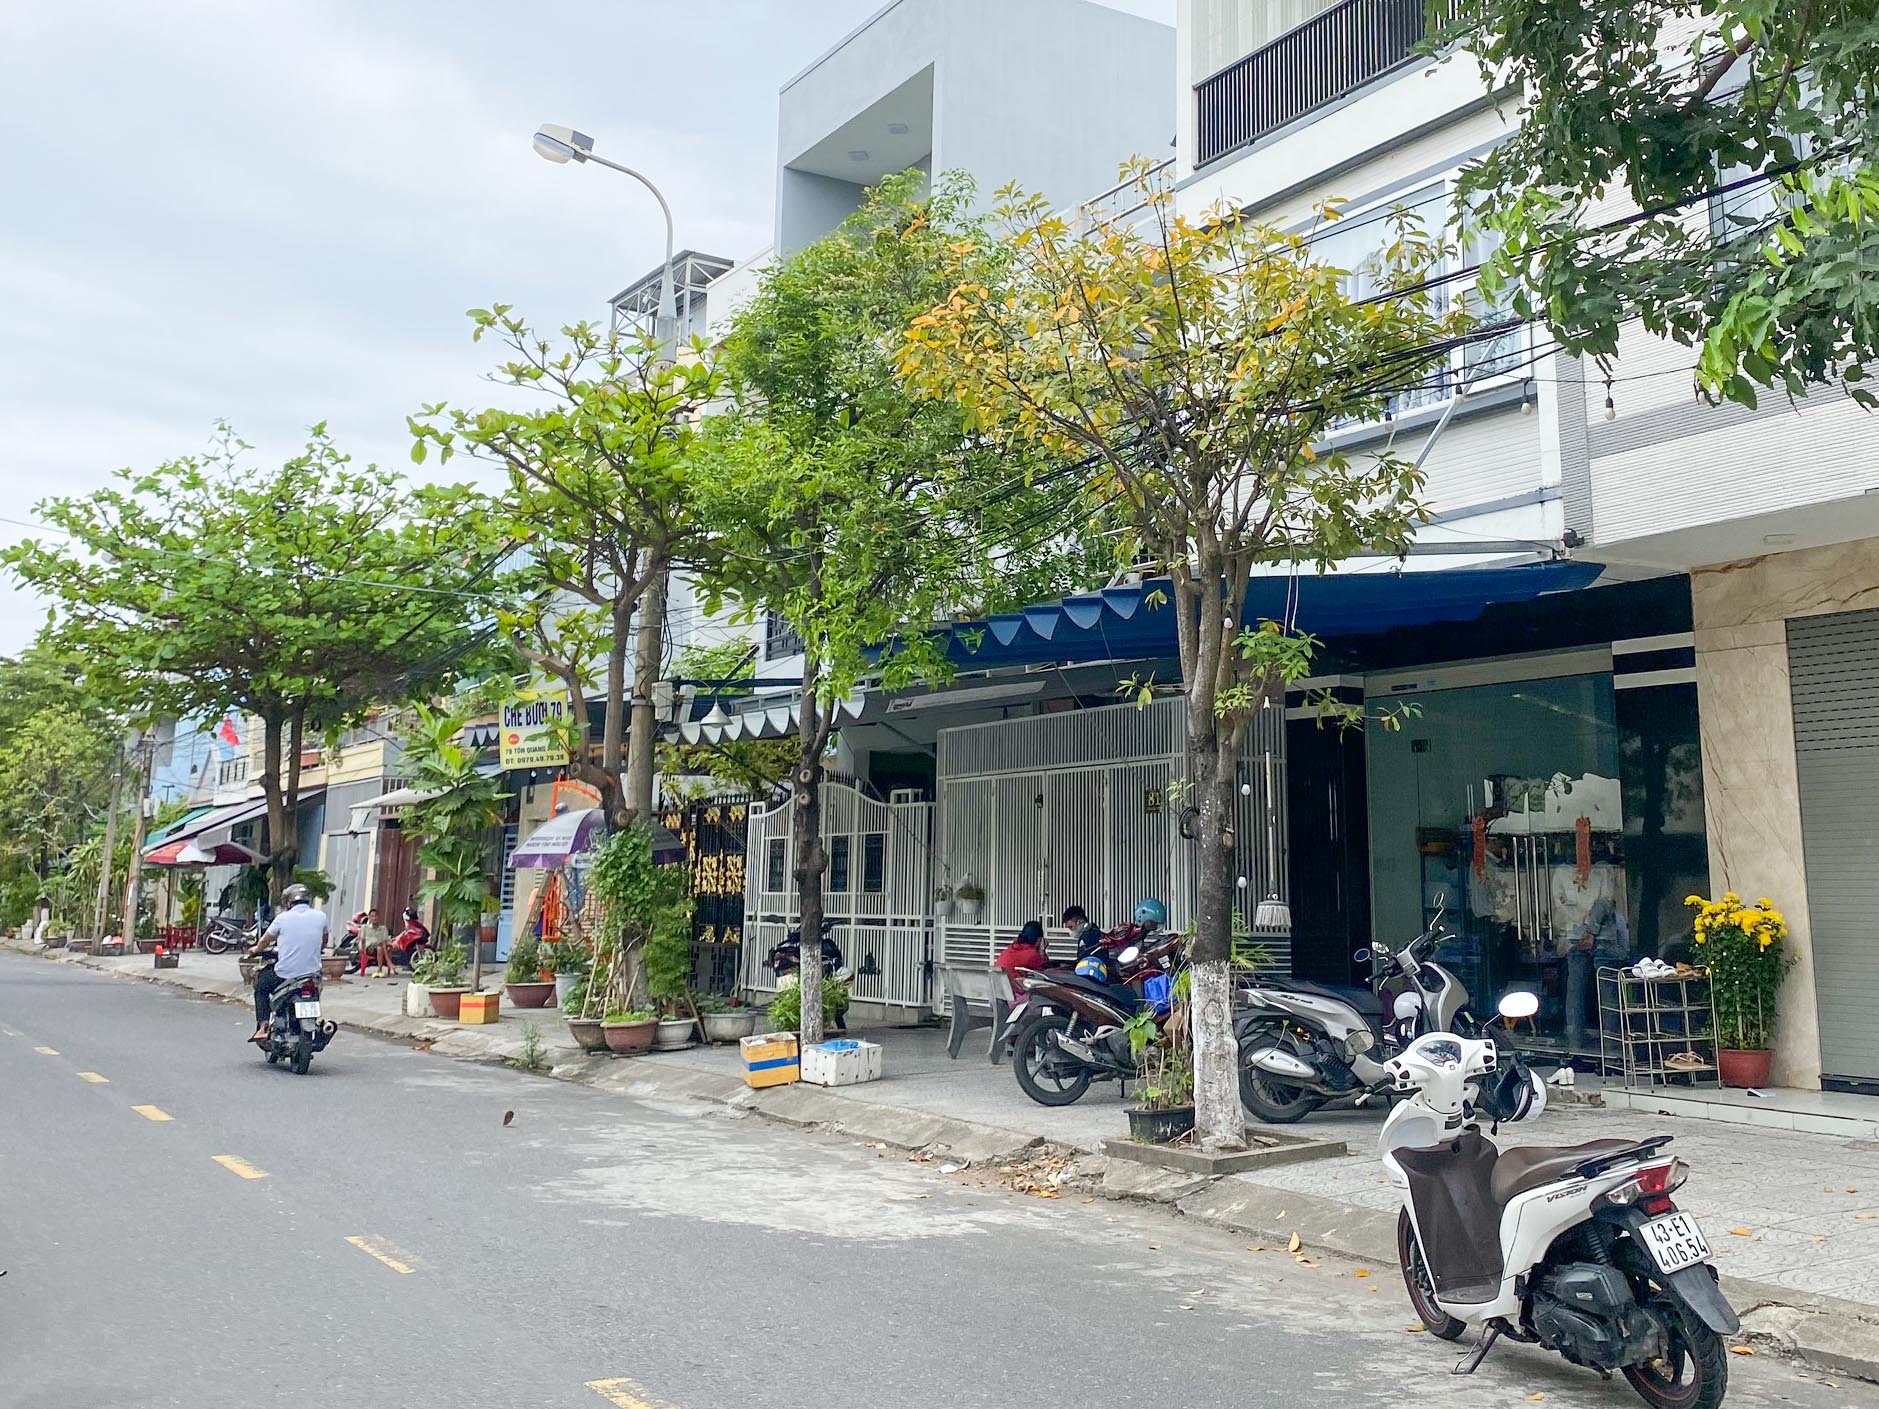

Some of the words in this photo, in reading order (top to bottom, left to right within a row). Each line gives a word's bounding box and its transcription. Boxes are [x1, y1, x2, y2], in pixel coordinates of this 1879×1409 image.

[551, 701, 562, 722] 79
[1148, 792, 1160, 806] 81
[1658, 1235, 1709, 1269] 406.54
